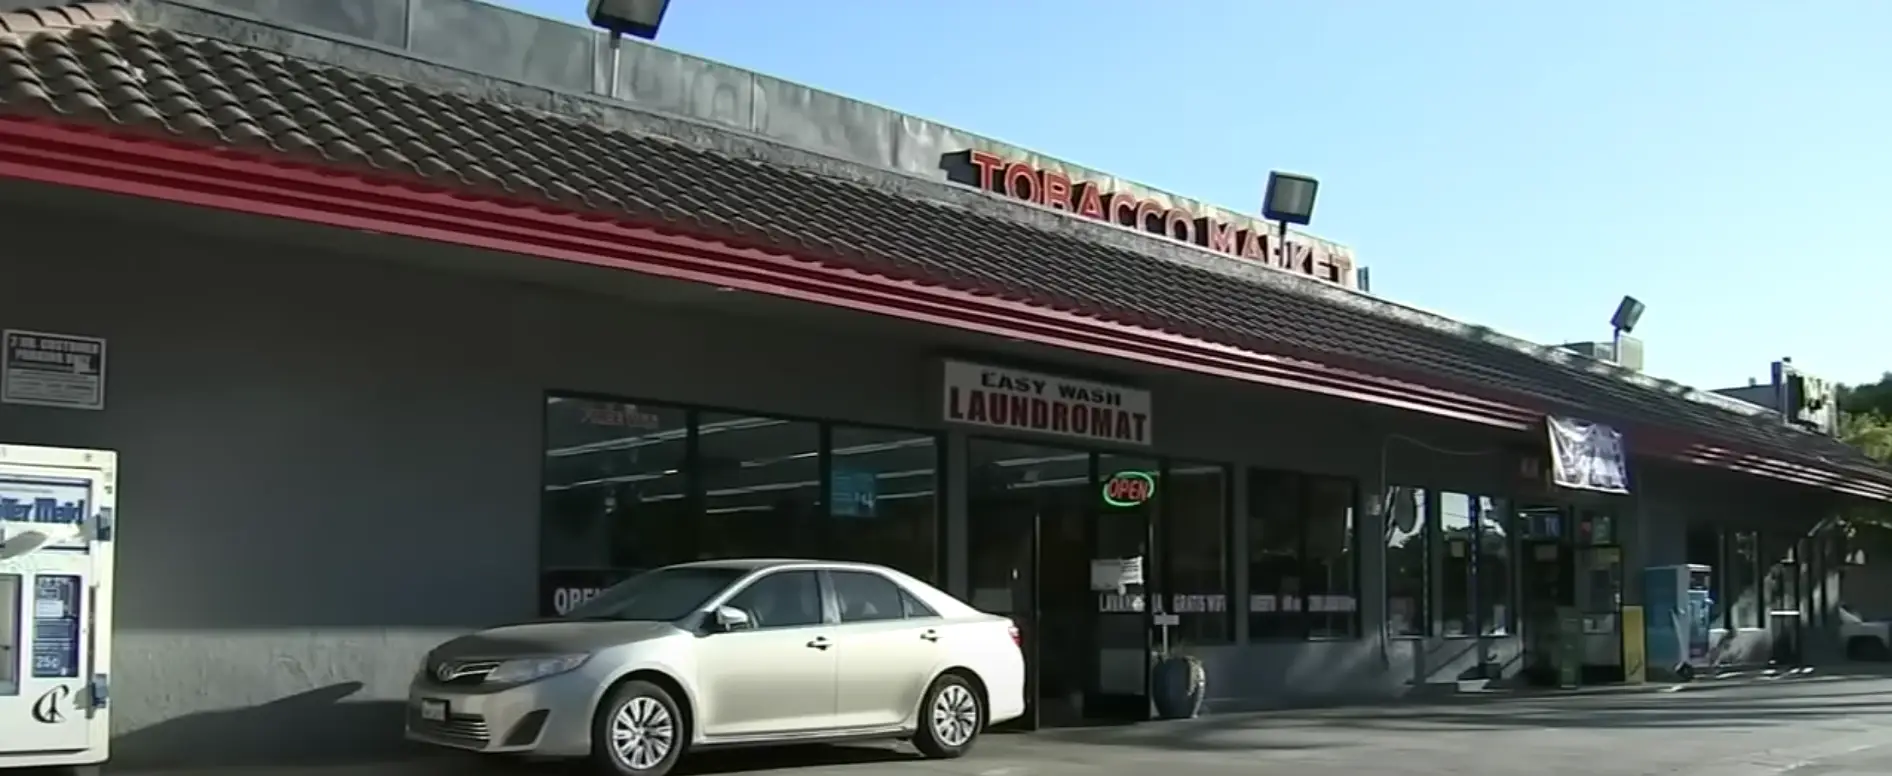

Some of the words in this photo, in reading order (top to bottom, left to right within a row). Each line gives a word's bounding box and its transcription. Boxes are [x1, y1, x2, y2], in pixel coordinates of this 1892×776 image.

[971, 150, 1197, 246] TOBACCO
[1208, 218, 1353, 288] MARKET
[981, 371, 1046, 396] EASY
[1058, 383, 1122, 406] WASH
[949, 386, 1148, 442] LAUNDROMAT
[1107, 478, 1150, 501] OPEN
